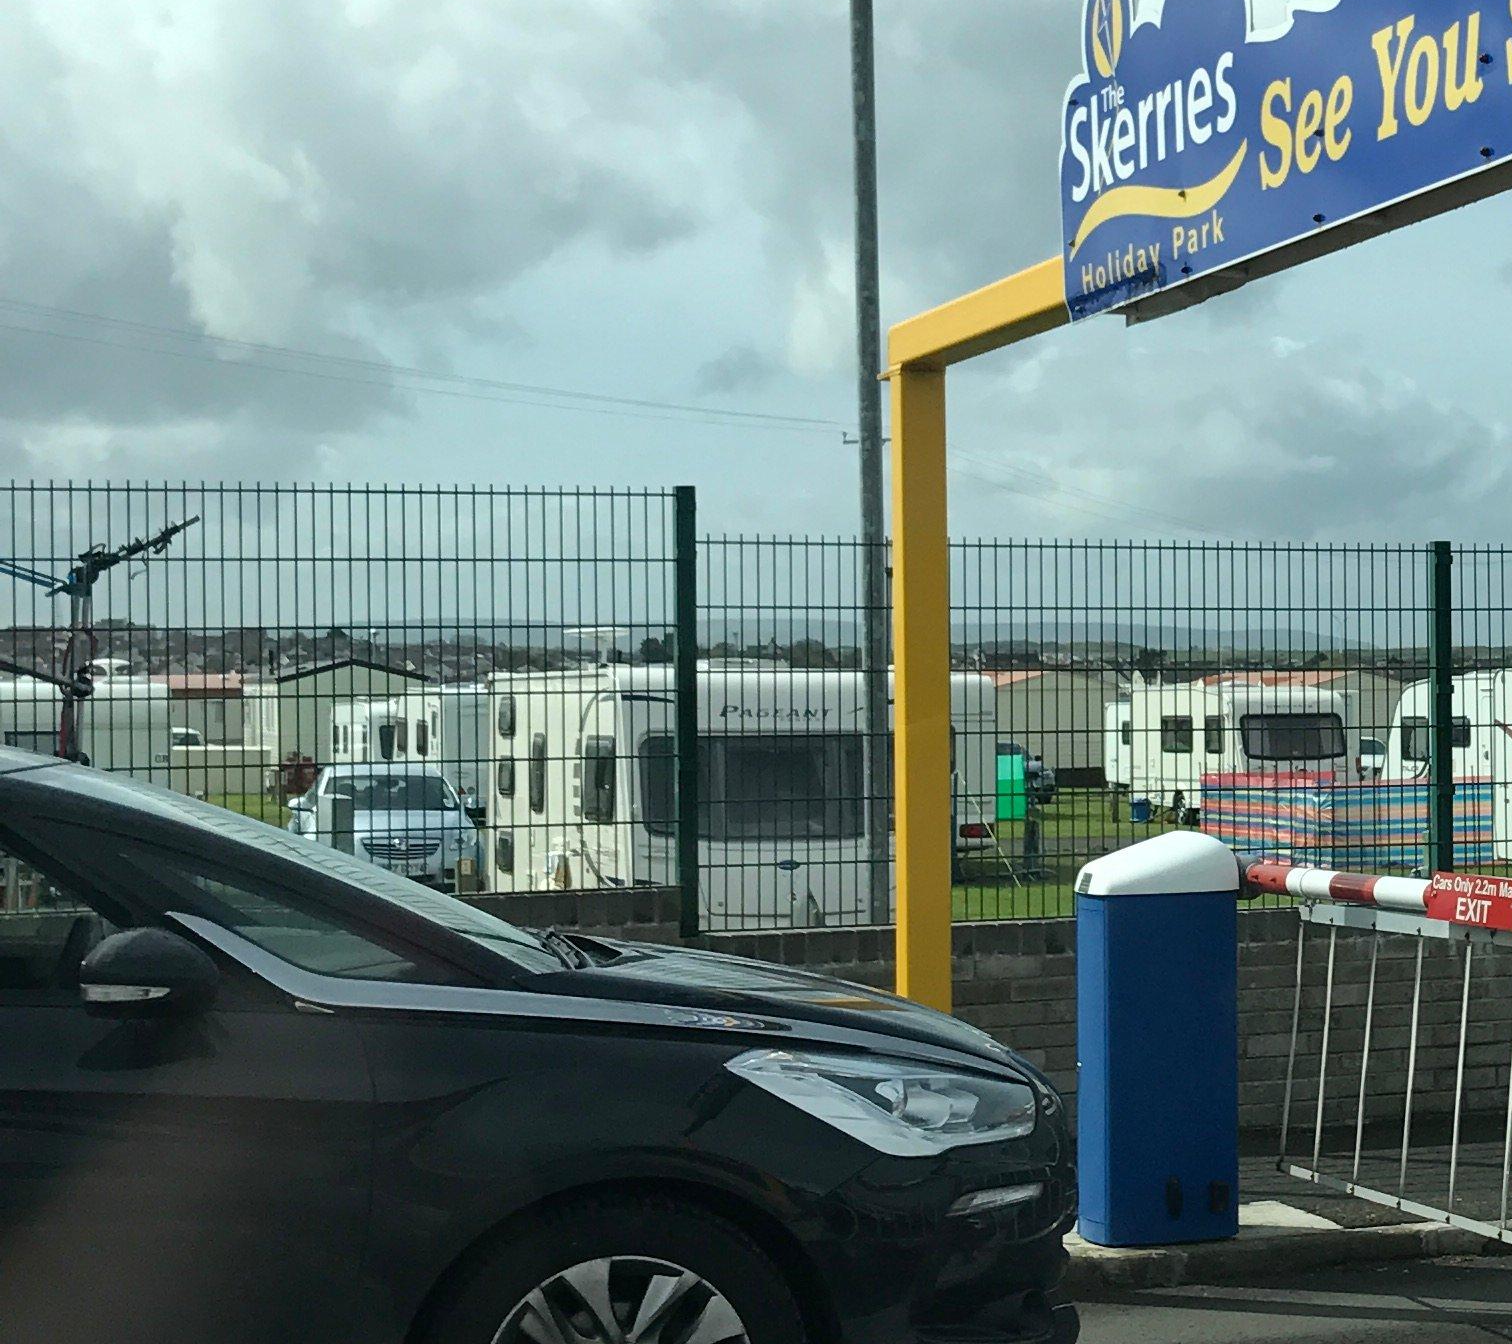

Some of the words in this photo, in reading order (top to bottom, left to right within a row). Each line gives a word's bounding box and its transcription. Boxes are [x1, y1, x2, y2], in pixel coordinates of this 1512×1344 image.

[1101, 85, 1125, 112] The
[1260, 71, 1353, 191] See
[1371, 10, 1483, 143] You
[1070, 51, 1237, 203] Skerries
[1081, 242, 1161, 295] Holiday
[1172, 209, 1225, 260] Park
[1432, 874, 1452, 890] Cars
[1454, 876, 1474, 897] Only
[1475, 879, 1497, 896] 2.2m
[1455, 897, 1492, 924] EXIT
